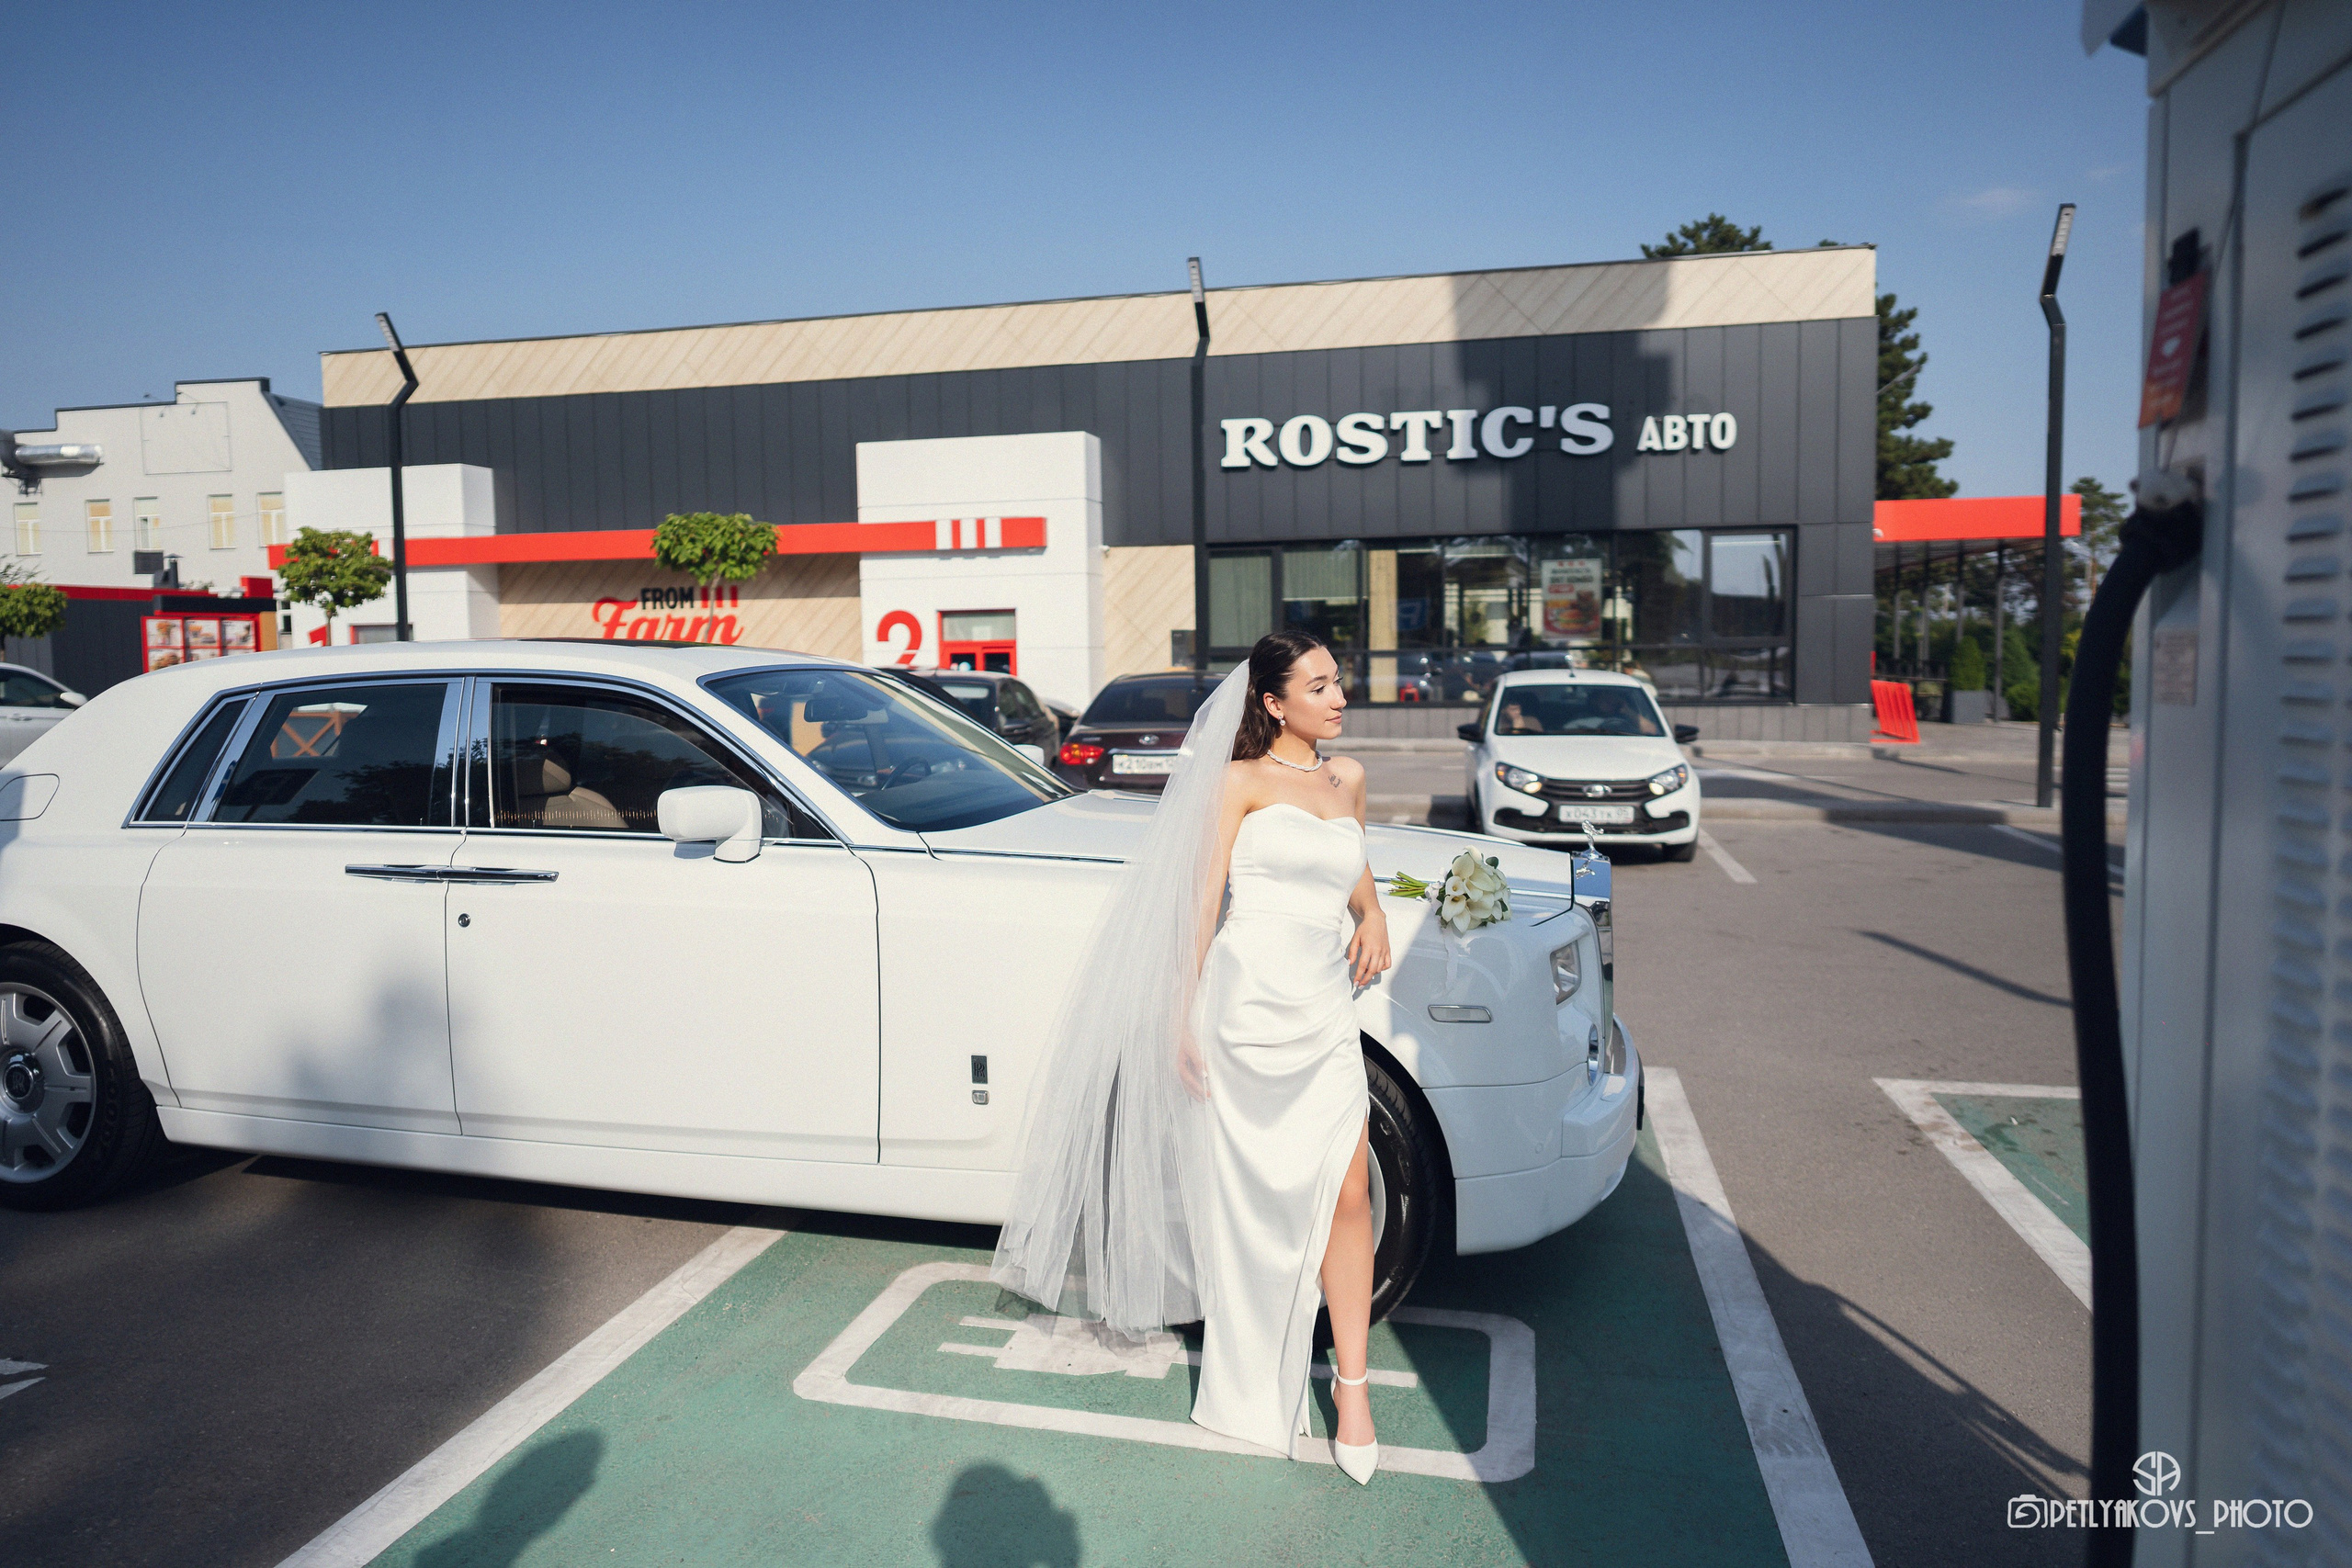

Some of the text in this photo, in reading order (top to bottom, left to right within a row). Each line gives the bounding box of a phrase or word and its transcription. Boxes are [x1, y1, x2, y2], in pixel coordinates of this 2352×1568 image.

[1220, 402, 1614, 468] ROSTIC'S
[1636, 412, 1737, 451] АВТО
[640, 586, 695, 610] FROM
[592, 597, 744, 646] Farm
